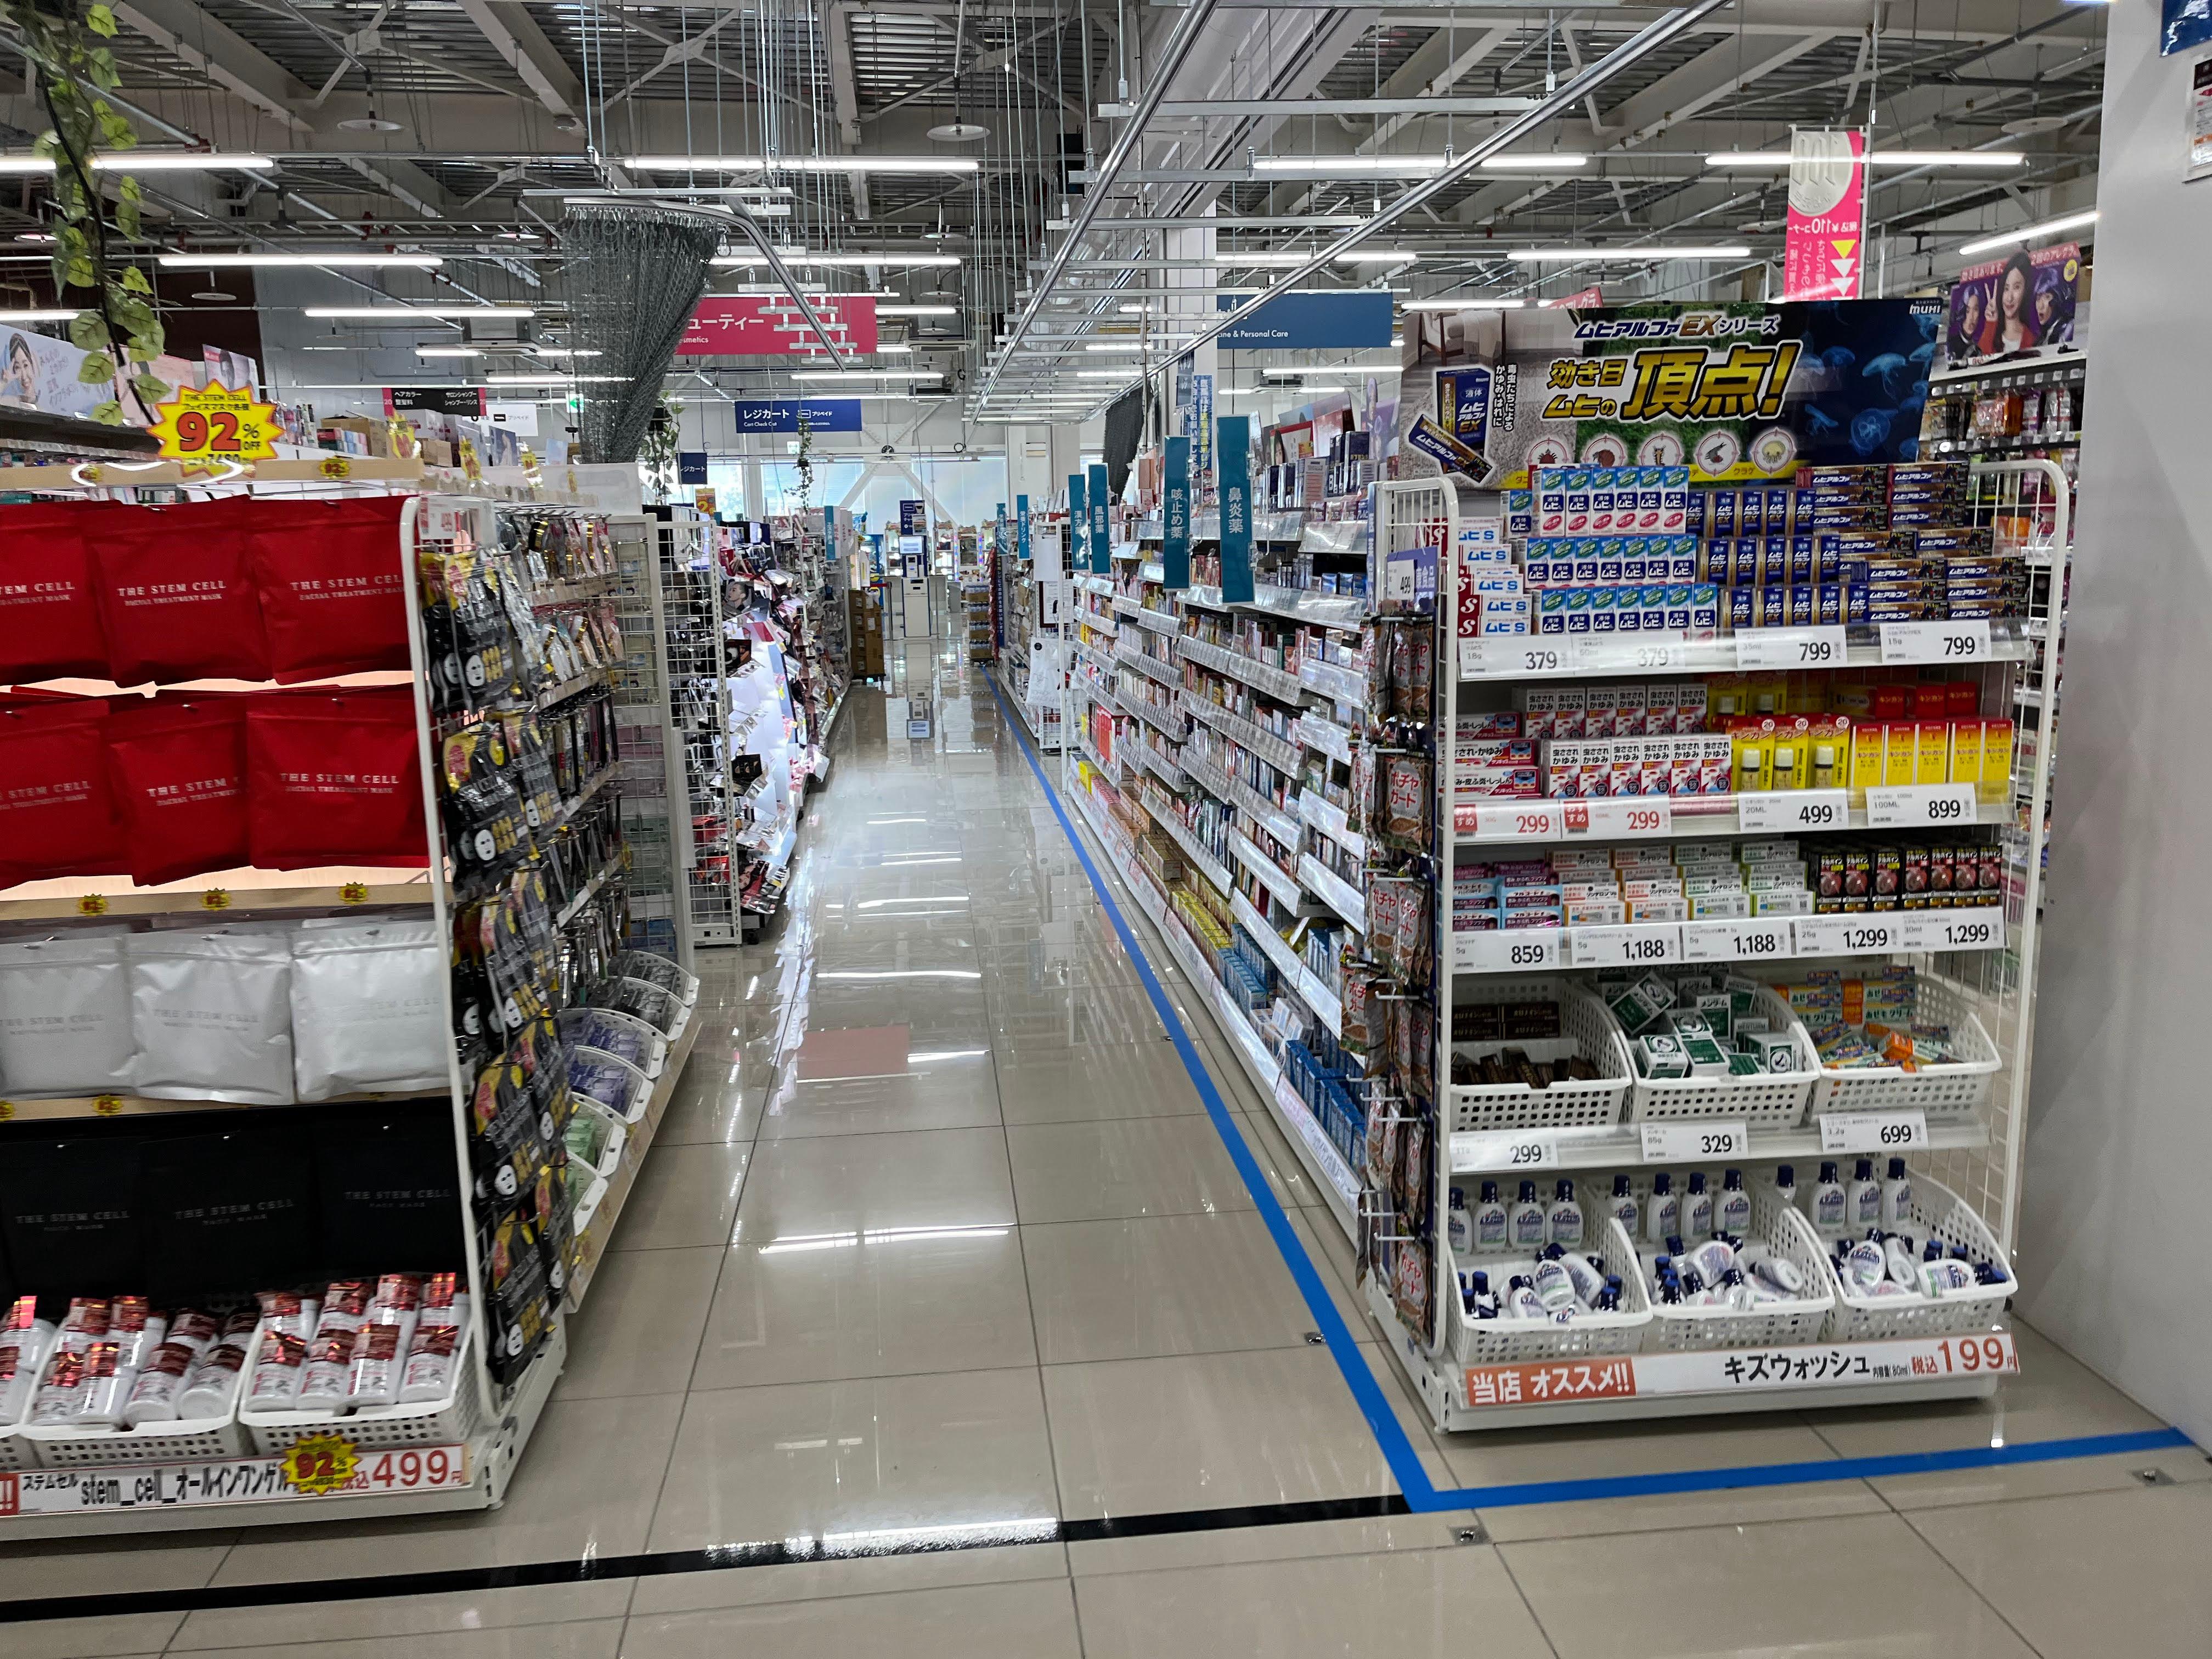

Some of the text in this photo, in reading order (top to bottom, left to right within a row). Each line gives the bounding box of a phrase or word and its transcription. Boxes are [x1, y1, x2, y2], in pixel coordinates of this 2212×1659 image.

[1240, 329, 1270, 338] Personal
[1271, 330, 1289, 338] Care
[1573, 314, 1780, 339] ムヒアルファEXシリーズ
[1547, 358, 1628, 389] 効き目
[743, 409, 789, 419] レジカート
[1542, 393, 1616, 420] ムヒの
[177, 411, 260, 452] 92 %
[1170, 488, 1183, 539] 咳止め薬
[1228, 487, 1244, 534] 鼻炎薬
[1468, 550, 1506, 561] ムヒS
[34, 581, 75, 592] CELL
[117, 580, 226, 596] THE STEM CELL
[290, 580, 321, 590] THE
[327, 577, 368, 588] STEM
[1479, 580, 1517, 590] ムヒS
[1487, 601, 1527, 612] ムヒS
[1485, 622, 1525, 633] ムヒS
[1799, 642, 1831, 662] 799
[1943, 636, 1976, 656] 799
[1525, 651, 1557, 670] 379
[1638, 647, 1669, 667] 379
[1553, 748, 1579, 757] 虫さされ
[1582, 747, 1610, 755] 虫さされ
[1644, 744, 1670, 752] 虫さされ
[1644, 752, 1669, 760] かゆみ
[1553, 756, 1578, 765] かゆみ
[1582, 755, 1609, 764] かゆみ
[146, 777, 227, 797] THE STEM
[280, 772, 399, 784] THE STEM CELL
[1799, 805, 1833, 824] 499
[1928, 800, 1961, 819] 899
[1516, 815, 1550, 834] 299
[1627, 811, 1660, 830] 299
[1843, 928, 1887, 950] 1,299
[1945, 923, 1989, 945] 1,299
[1511, 944, 1544, 964] 859
[1622, 939, 1665, 960] 1,188
[1734, 934, 1776, 955] 1,188
[1701, 1134, 1733, 1153] 329
[1881, 1124, 1912, 1144] 699
[1510, 1144, 1542, 1165] 299
[1472, 1372, 1522, 1404] 当店
[1724, 1351, 1870, 1384] キズウォッシュ
[1911, 1355, 1938, 1376] 税込
[1937, 1338, 2004, 1373] 199
[22, 1472, 78, 1492] ステムセル
[373, 1450, 449, 1487] 499
[296, 1452, 334, 1479] 92
